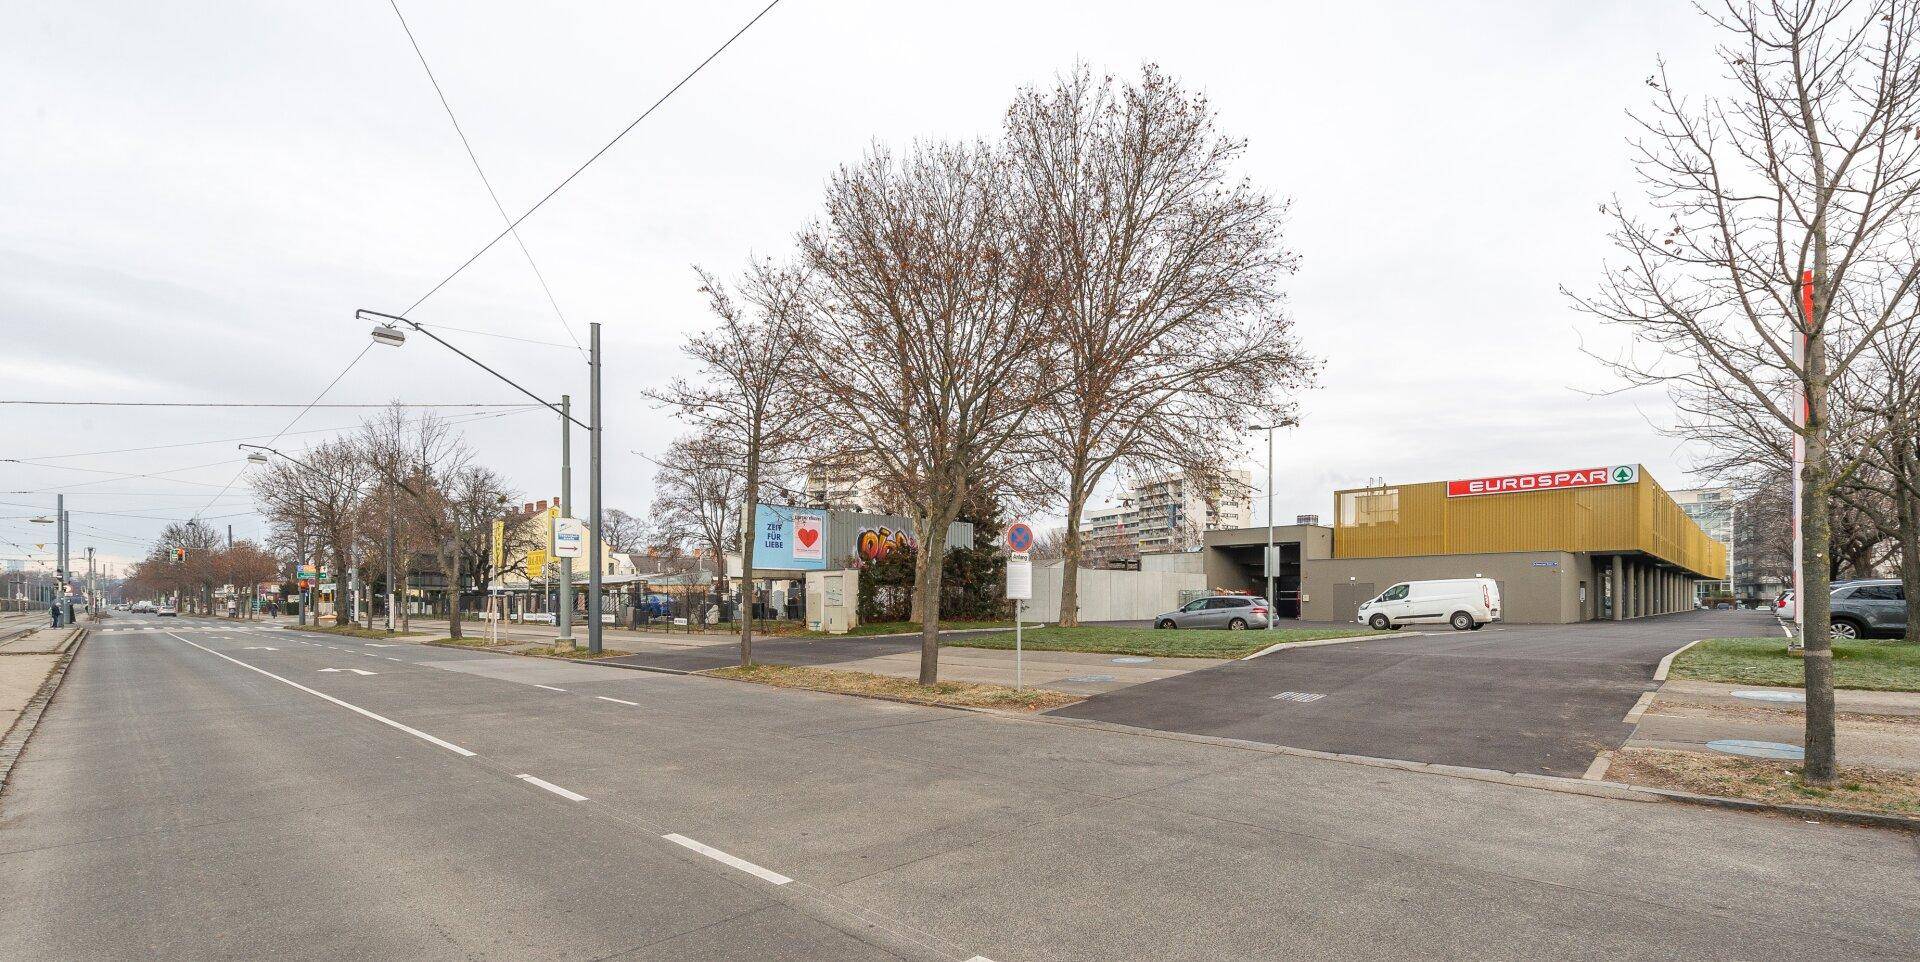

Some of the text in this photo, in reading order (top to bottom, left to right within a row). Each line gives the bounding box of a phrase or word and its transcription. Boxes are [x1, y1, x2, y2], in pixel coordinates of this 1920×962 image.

[1469, 470, 1606, 492] EUROSPAR
[766, 523, 782, 531] ZEIT
[767, 531, 782, 540] FÜR
[765, 540, 783, 548] LIEBE
